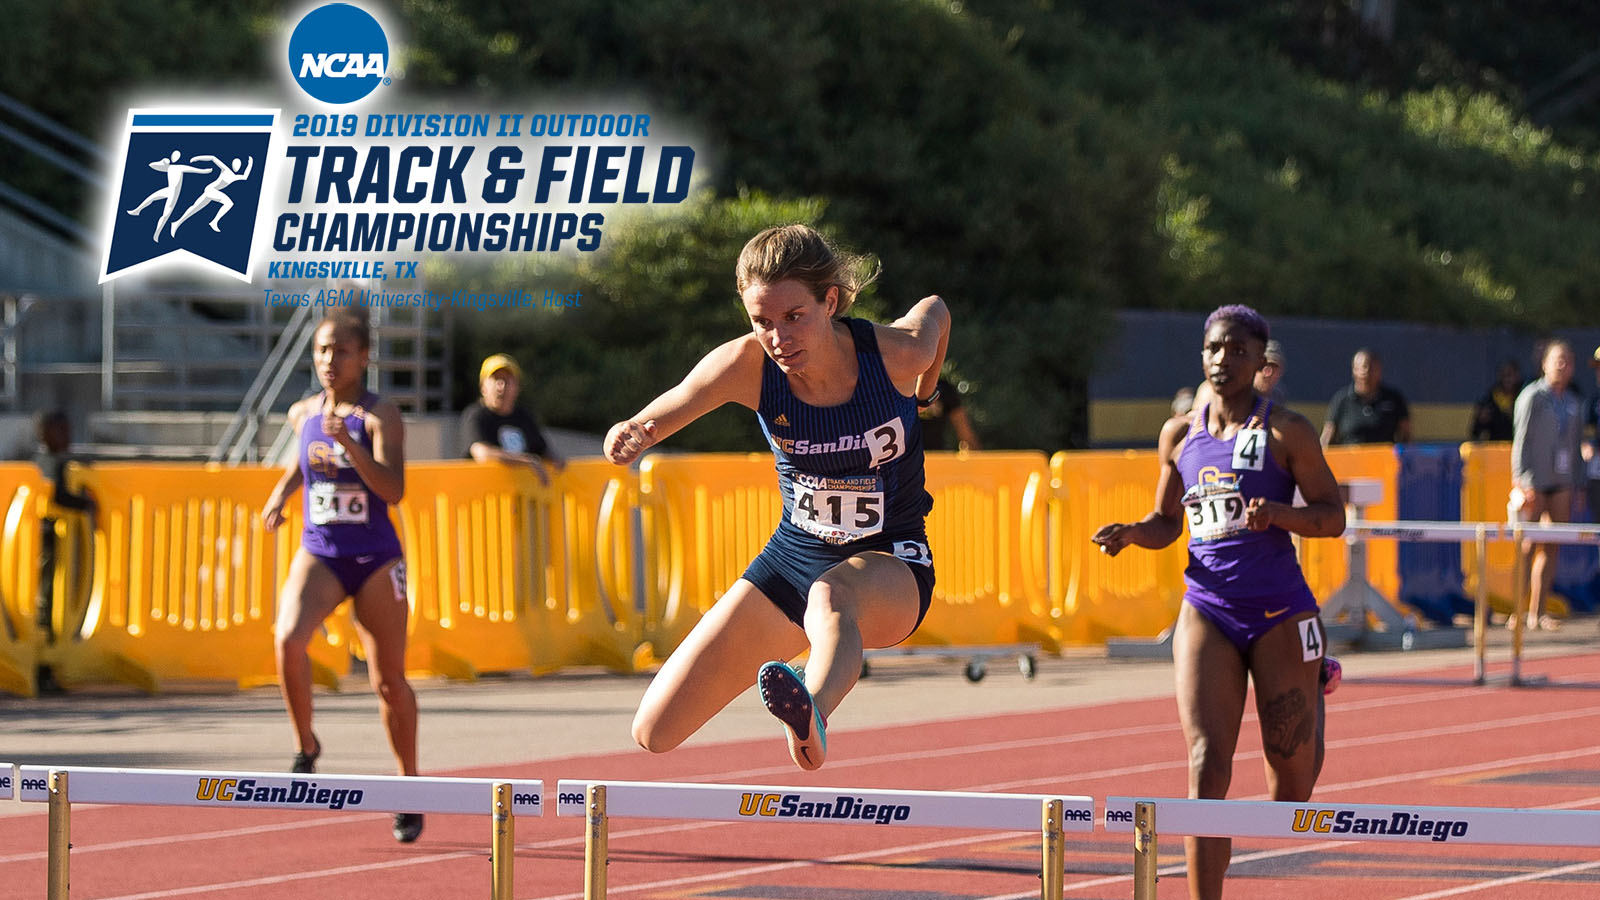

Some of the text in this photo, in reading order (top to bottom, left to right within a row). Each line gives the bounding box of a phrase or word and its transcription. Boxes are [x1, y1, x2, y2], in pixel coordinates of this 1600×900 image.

[874, 426, 898, 463] 3
[1240, 434, 1259, 467] 4
[798, 492, 880, 528] 415
[1188, 497, 1243, 526] 319
[1307, 621, 1319, 656] 4
